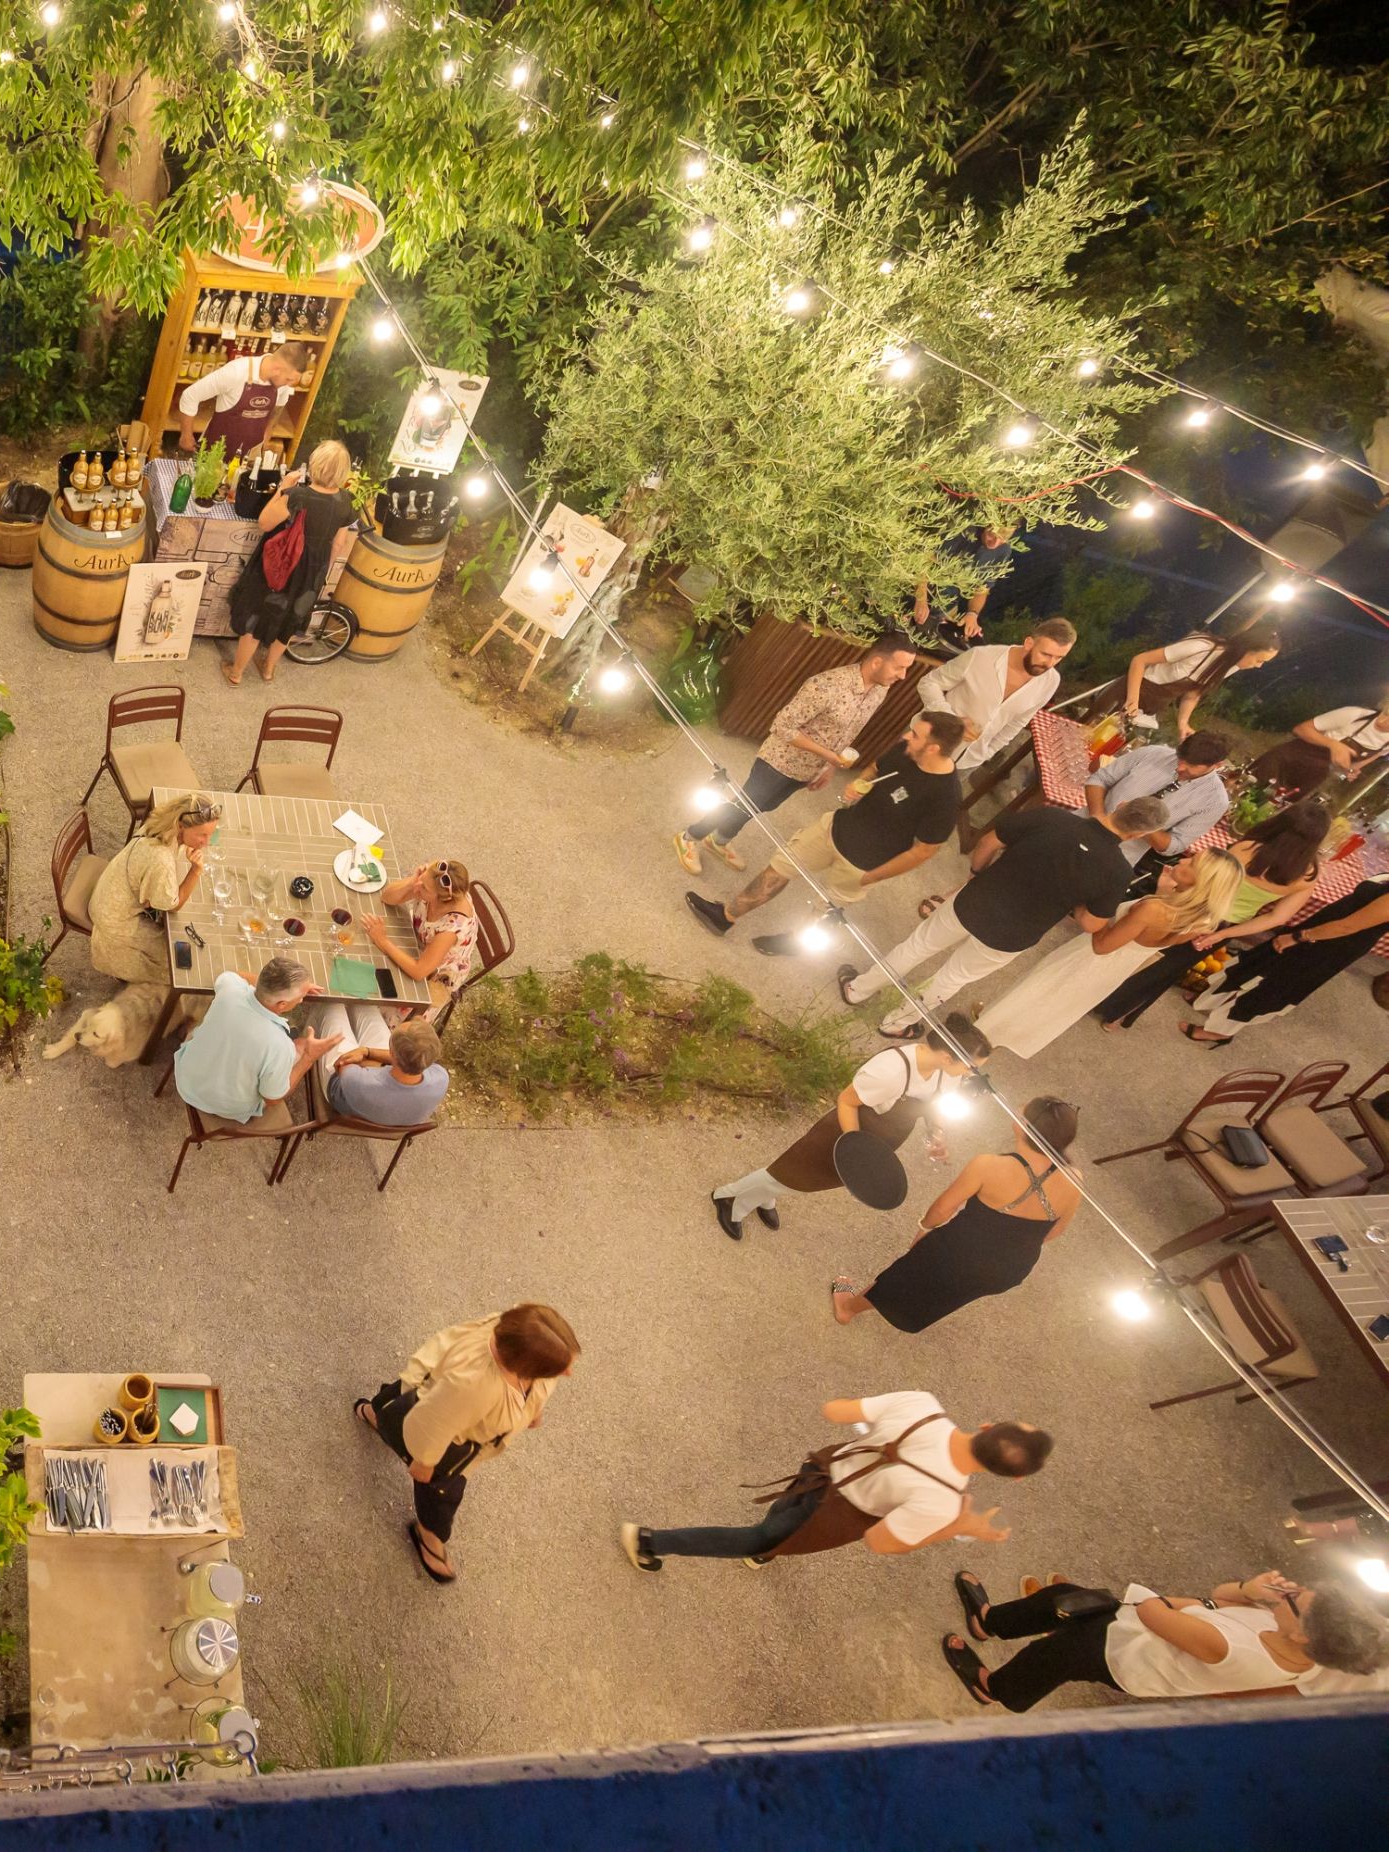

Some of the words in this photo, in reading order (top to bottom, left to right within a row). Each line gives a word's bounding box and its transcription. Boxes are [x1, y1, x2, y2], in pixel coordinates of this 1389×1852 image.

[234, 531, 261, 542] Aur
[74, 553, 134, 570] AurA
[374, 566, 431, 583] AurA
[149, 609, 170, 624] KAR
